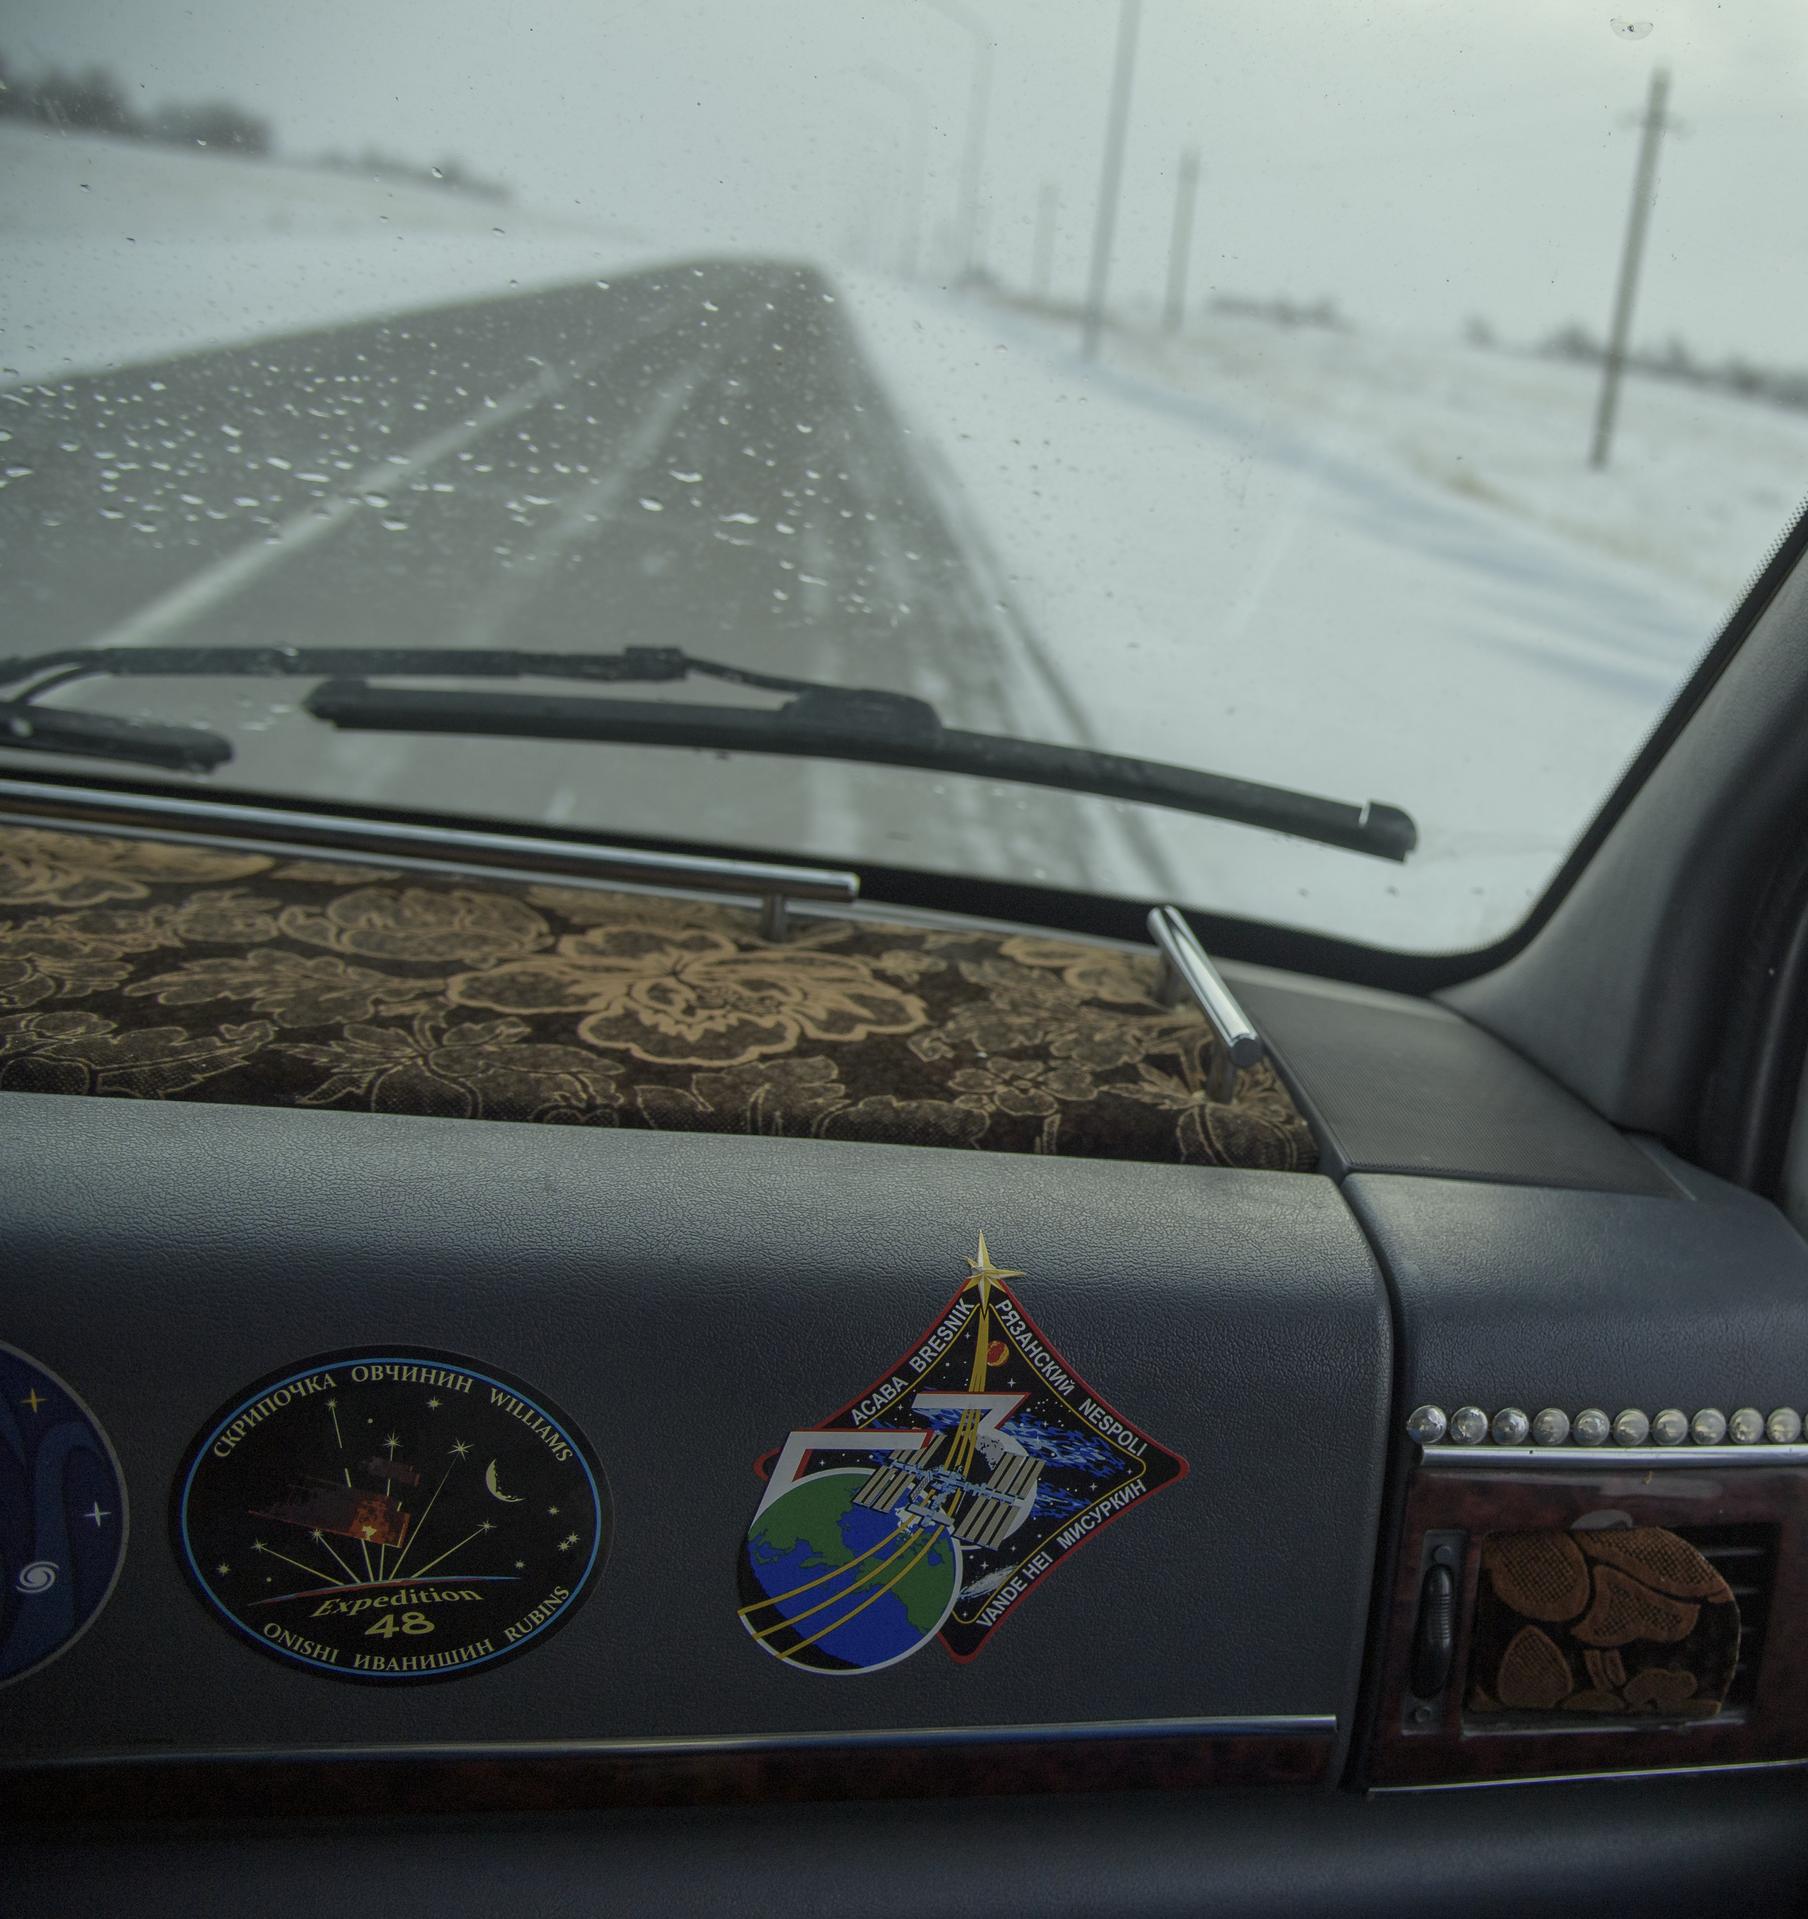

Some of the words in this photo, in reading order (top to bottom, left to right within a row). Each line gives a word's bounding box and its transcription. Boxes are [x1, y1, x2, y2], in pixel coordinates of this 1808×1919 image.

[851, 1376, 909, 1426] ACABA
[909, 1298, 976, 1374] BRESNIK
[995, 1299, 1076, 1397] РЯЗАНСКИЙ
[1078, 1398, 1148, 1457] NESPOLI
[213, 1373, 337, 1458] СКРИПОЧКА
[351, 1365, 474, 1394] ОВЧИНИН
[489, 1388, 573, 1462] WILLIAMS
[310, 1587, 484, 1617] Expedition
[975, 1572, 1028, 1629] VANDE
[1021, 1551, 1053, 1580] HEI
[1057, 1479, 1147, 1550] МИСУРКИН
[264, 1622, 339, 1664] ONISHI
[353, 1639, 495, 1672] ИВАНИШИН
[504, 1585, 570, 1643] RUBINS
[364, 1612, 435, 1639] 48
